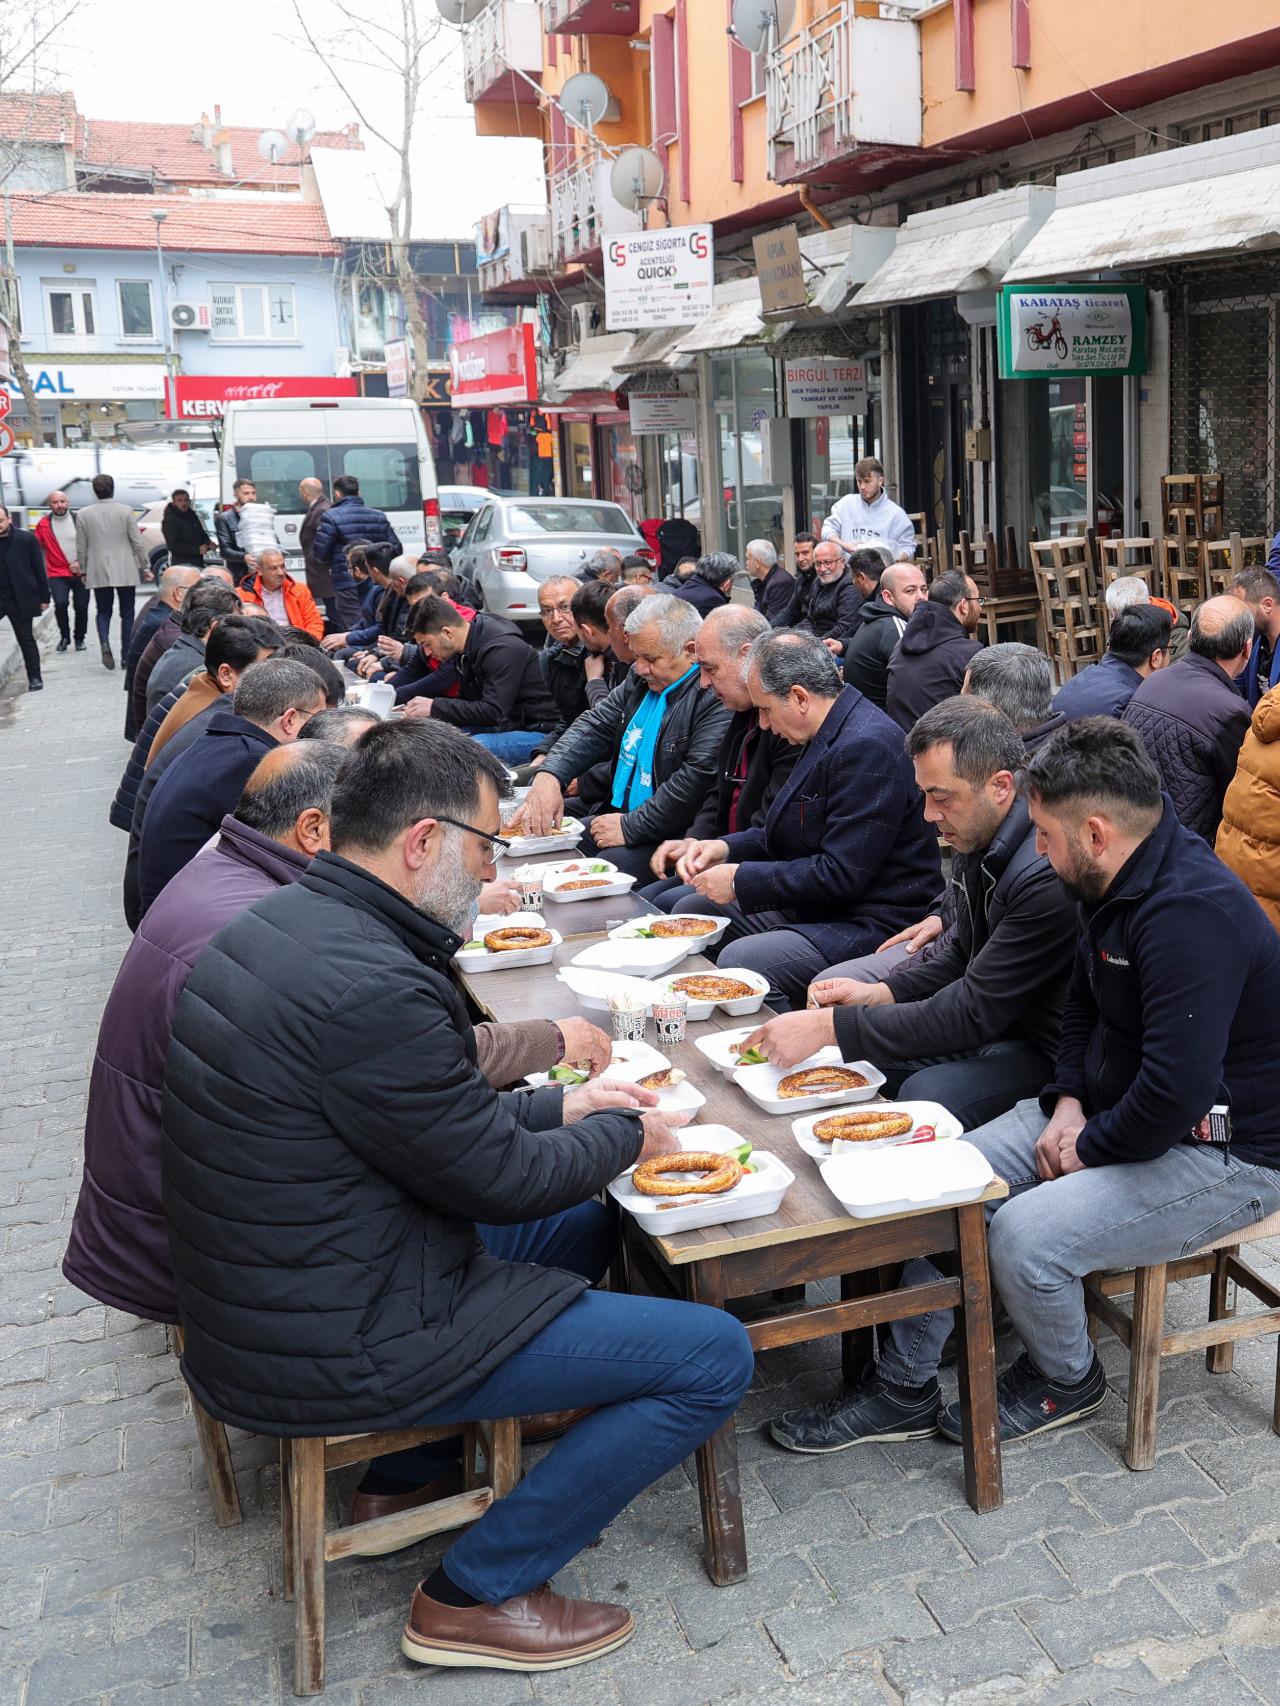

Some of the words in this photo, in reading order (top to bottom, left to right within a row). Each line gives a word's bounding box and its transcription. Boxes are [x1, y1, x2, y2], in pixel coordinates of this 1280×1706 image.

[656, 236, 686, 250] SİGORTA
[637, 265, 672, 280] QUICK
[1019, 298, 1081, 310] KARATAŞ
[1085, 298, 1126, 307] ticaret
[1072, 335, 1127, 346] RAMZEY
[787, 365, 830, 382] BİRGÜL
[832, 364, 863, 382] TERZİ
[805, 386, 825, 394] TÜRLÜ
